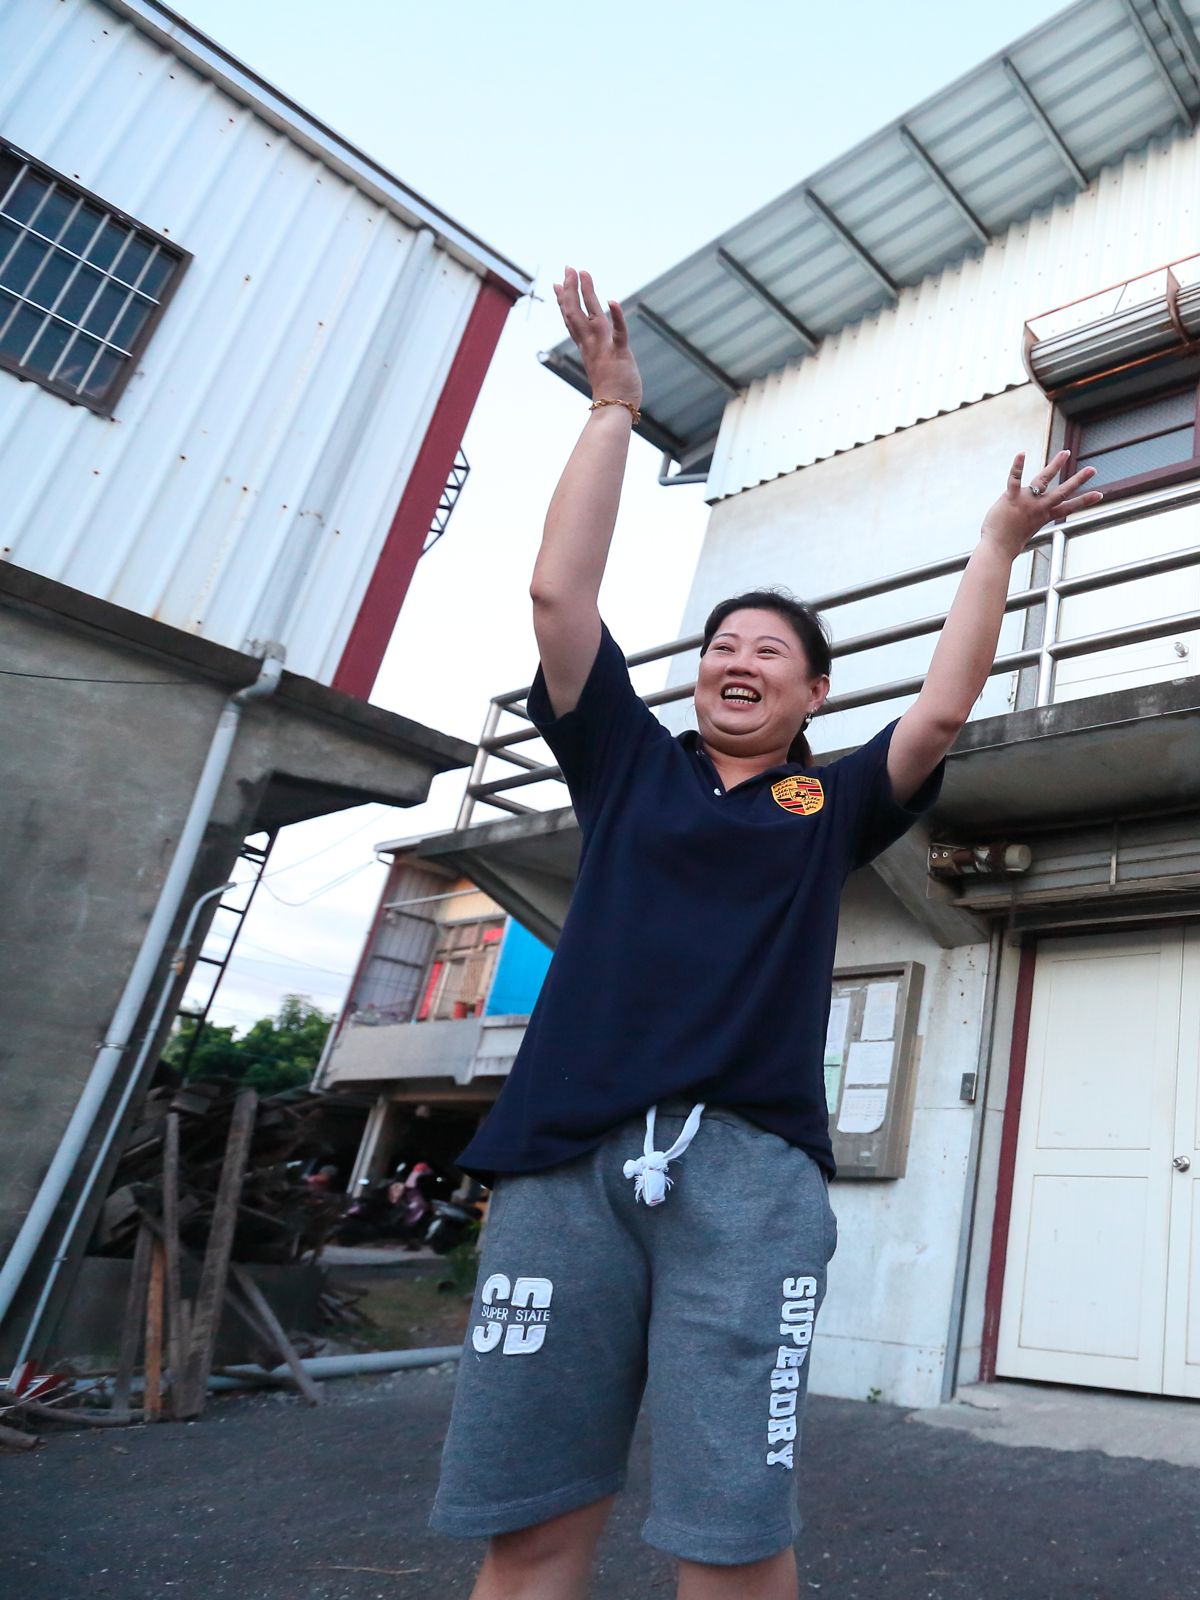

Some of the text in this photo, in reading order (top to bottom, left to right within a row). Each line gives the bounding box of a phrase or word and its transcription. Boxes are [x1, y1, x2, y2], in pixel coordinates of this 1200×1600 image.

[481, 1305, 551, 1322] SUPER STATE
[766, 1276, 817, 1470] SUPERDRY
